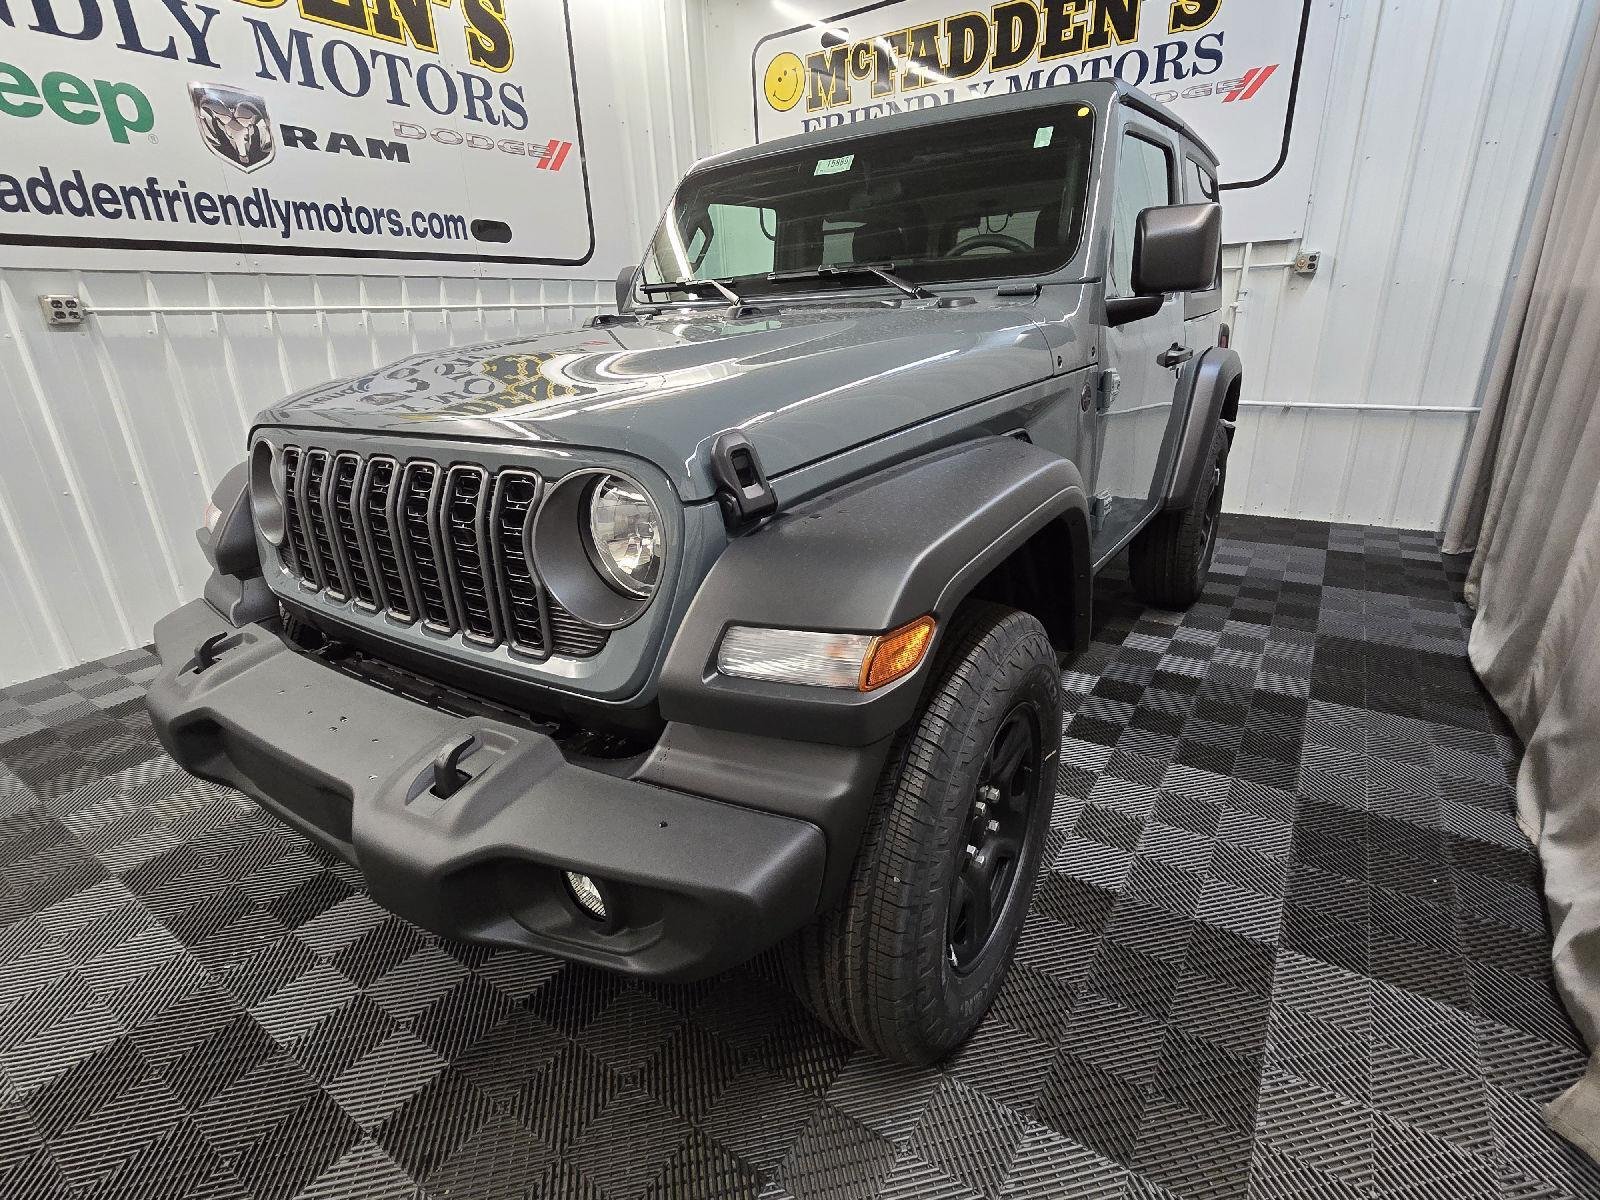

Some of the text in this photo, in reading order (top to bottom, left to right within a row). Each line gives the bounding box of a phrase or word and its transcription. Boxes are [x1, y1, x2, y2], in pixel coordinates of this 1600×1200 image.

[0, 0, 222, 69] DLY
[242, 16, 529, 131] MOTORS
[280, 123, 411, 164] RAM
[392, 120, 552, 160] DODGE
